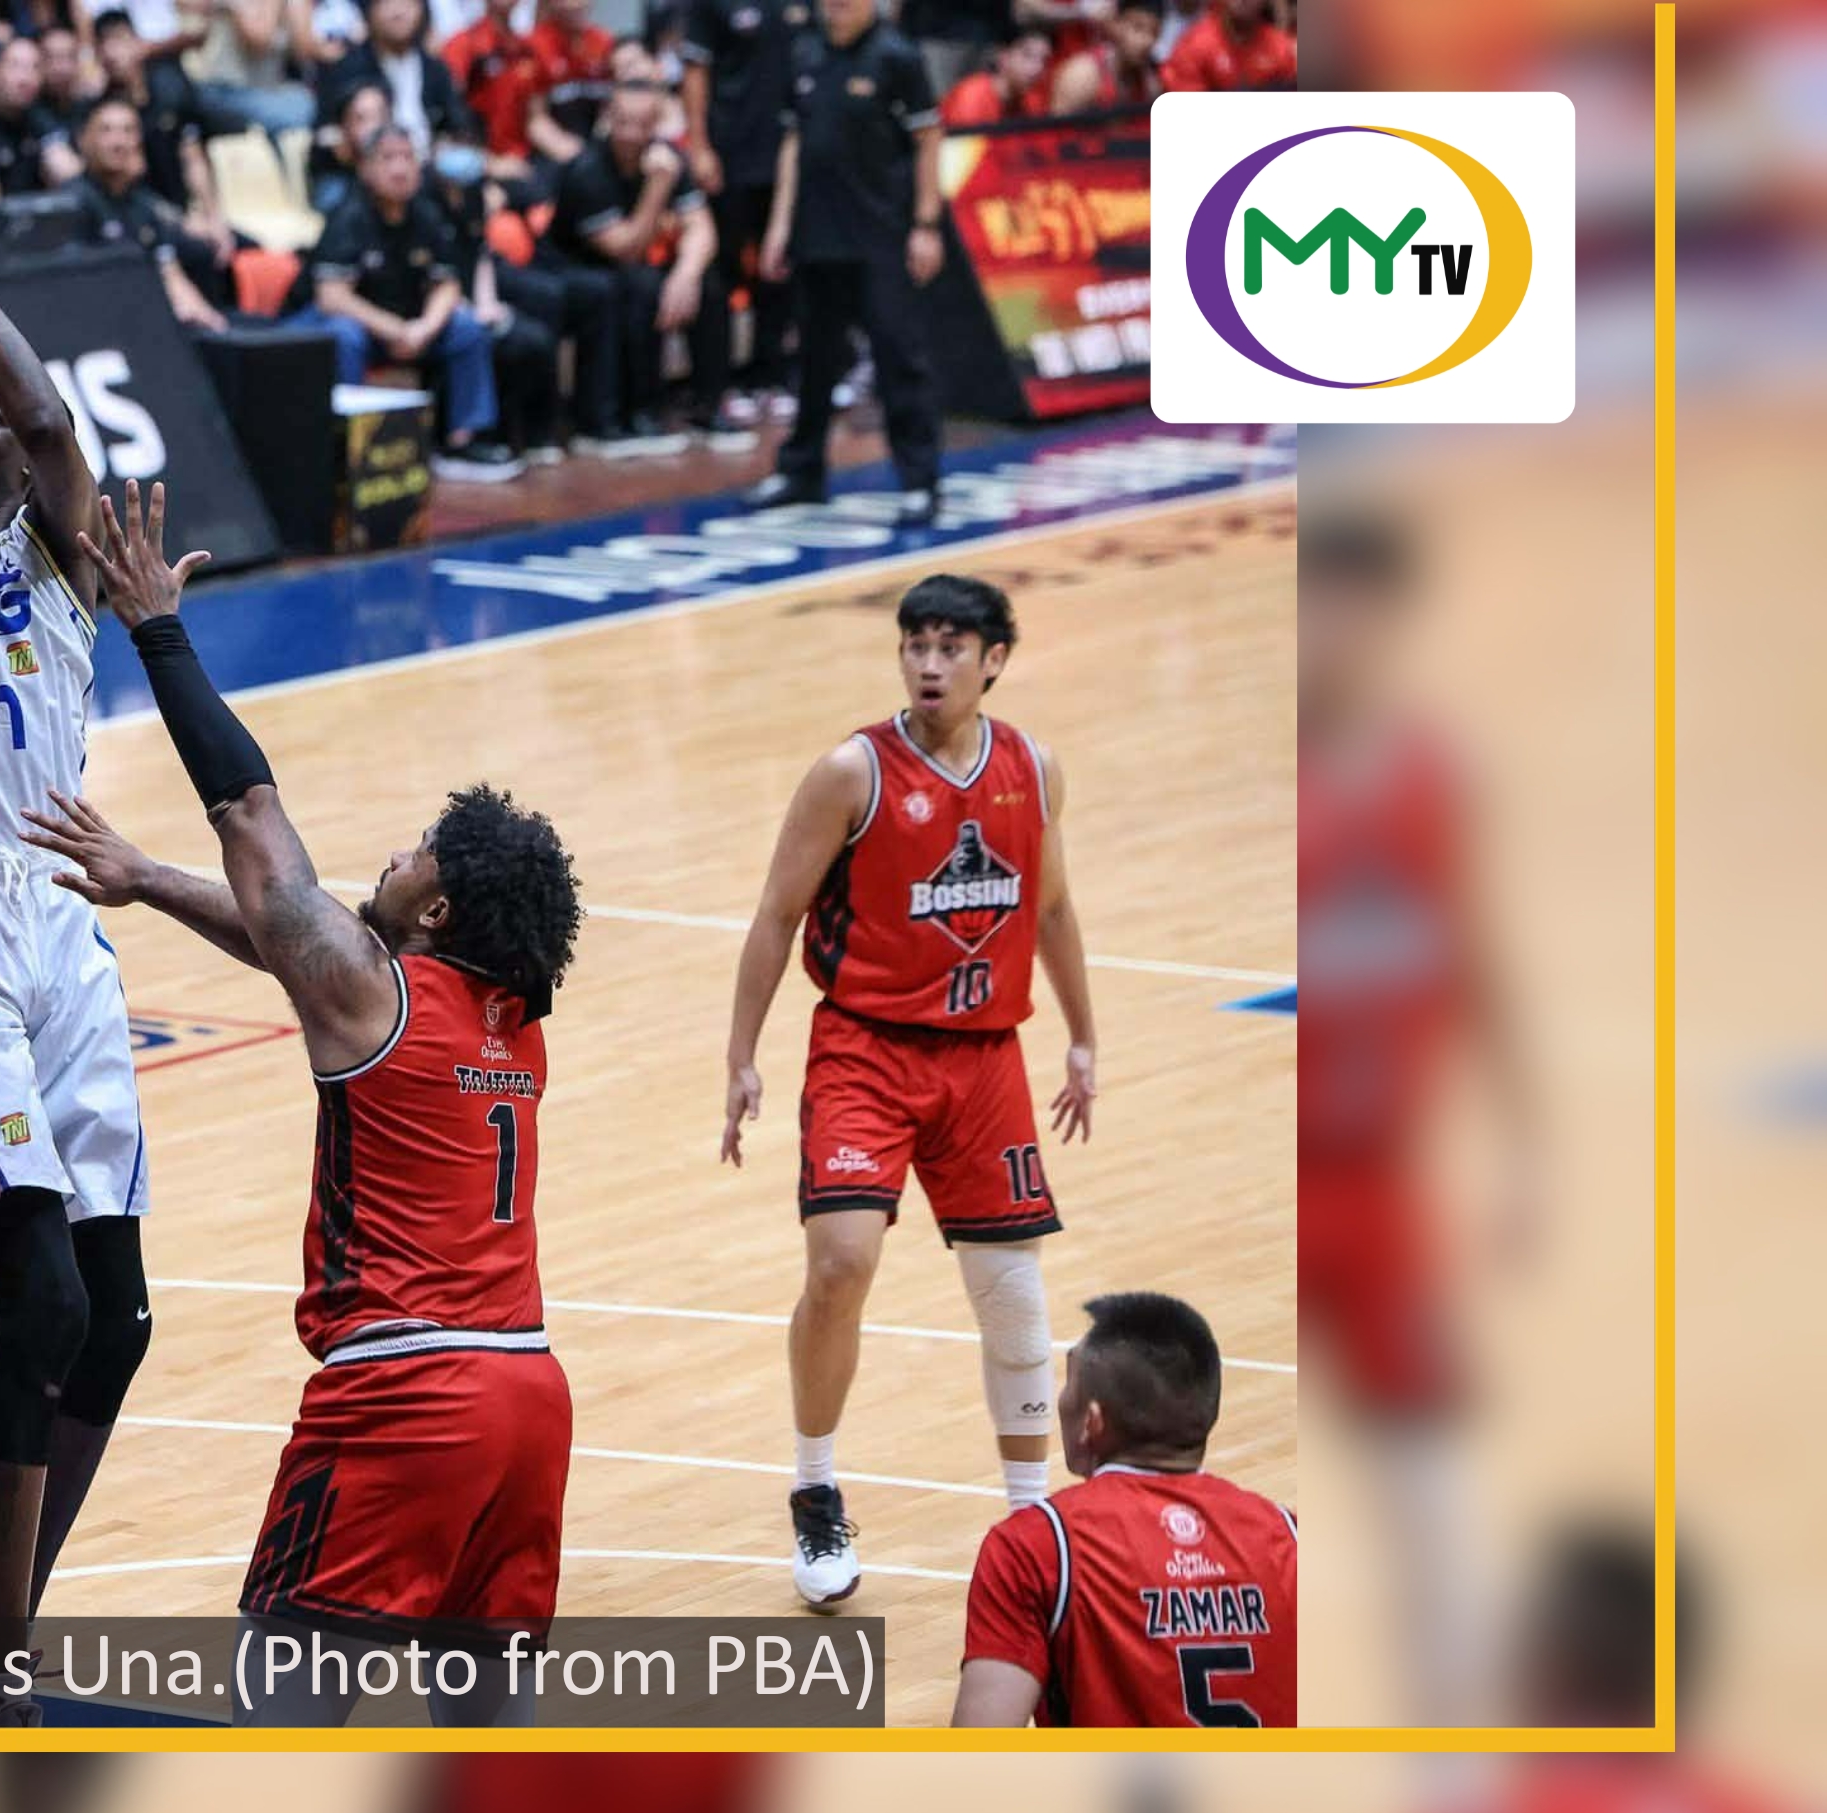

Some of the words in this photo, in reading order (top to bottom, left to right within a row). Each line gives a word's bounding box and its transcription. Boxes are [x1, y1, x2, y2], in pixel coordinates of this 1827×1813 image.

[910, 873, 1022, 917] BOSSIN
[946, 959, 992, 1014] 10
[0, 1115, 31, 1145] TNT
[486, 1101, 518, 1223] 1
[1001, 1143, 1047, 1204] 10
[1140, 1583, 1270, 1639] ZAMAR
[1176, 1643, 1262, 1728] 5
